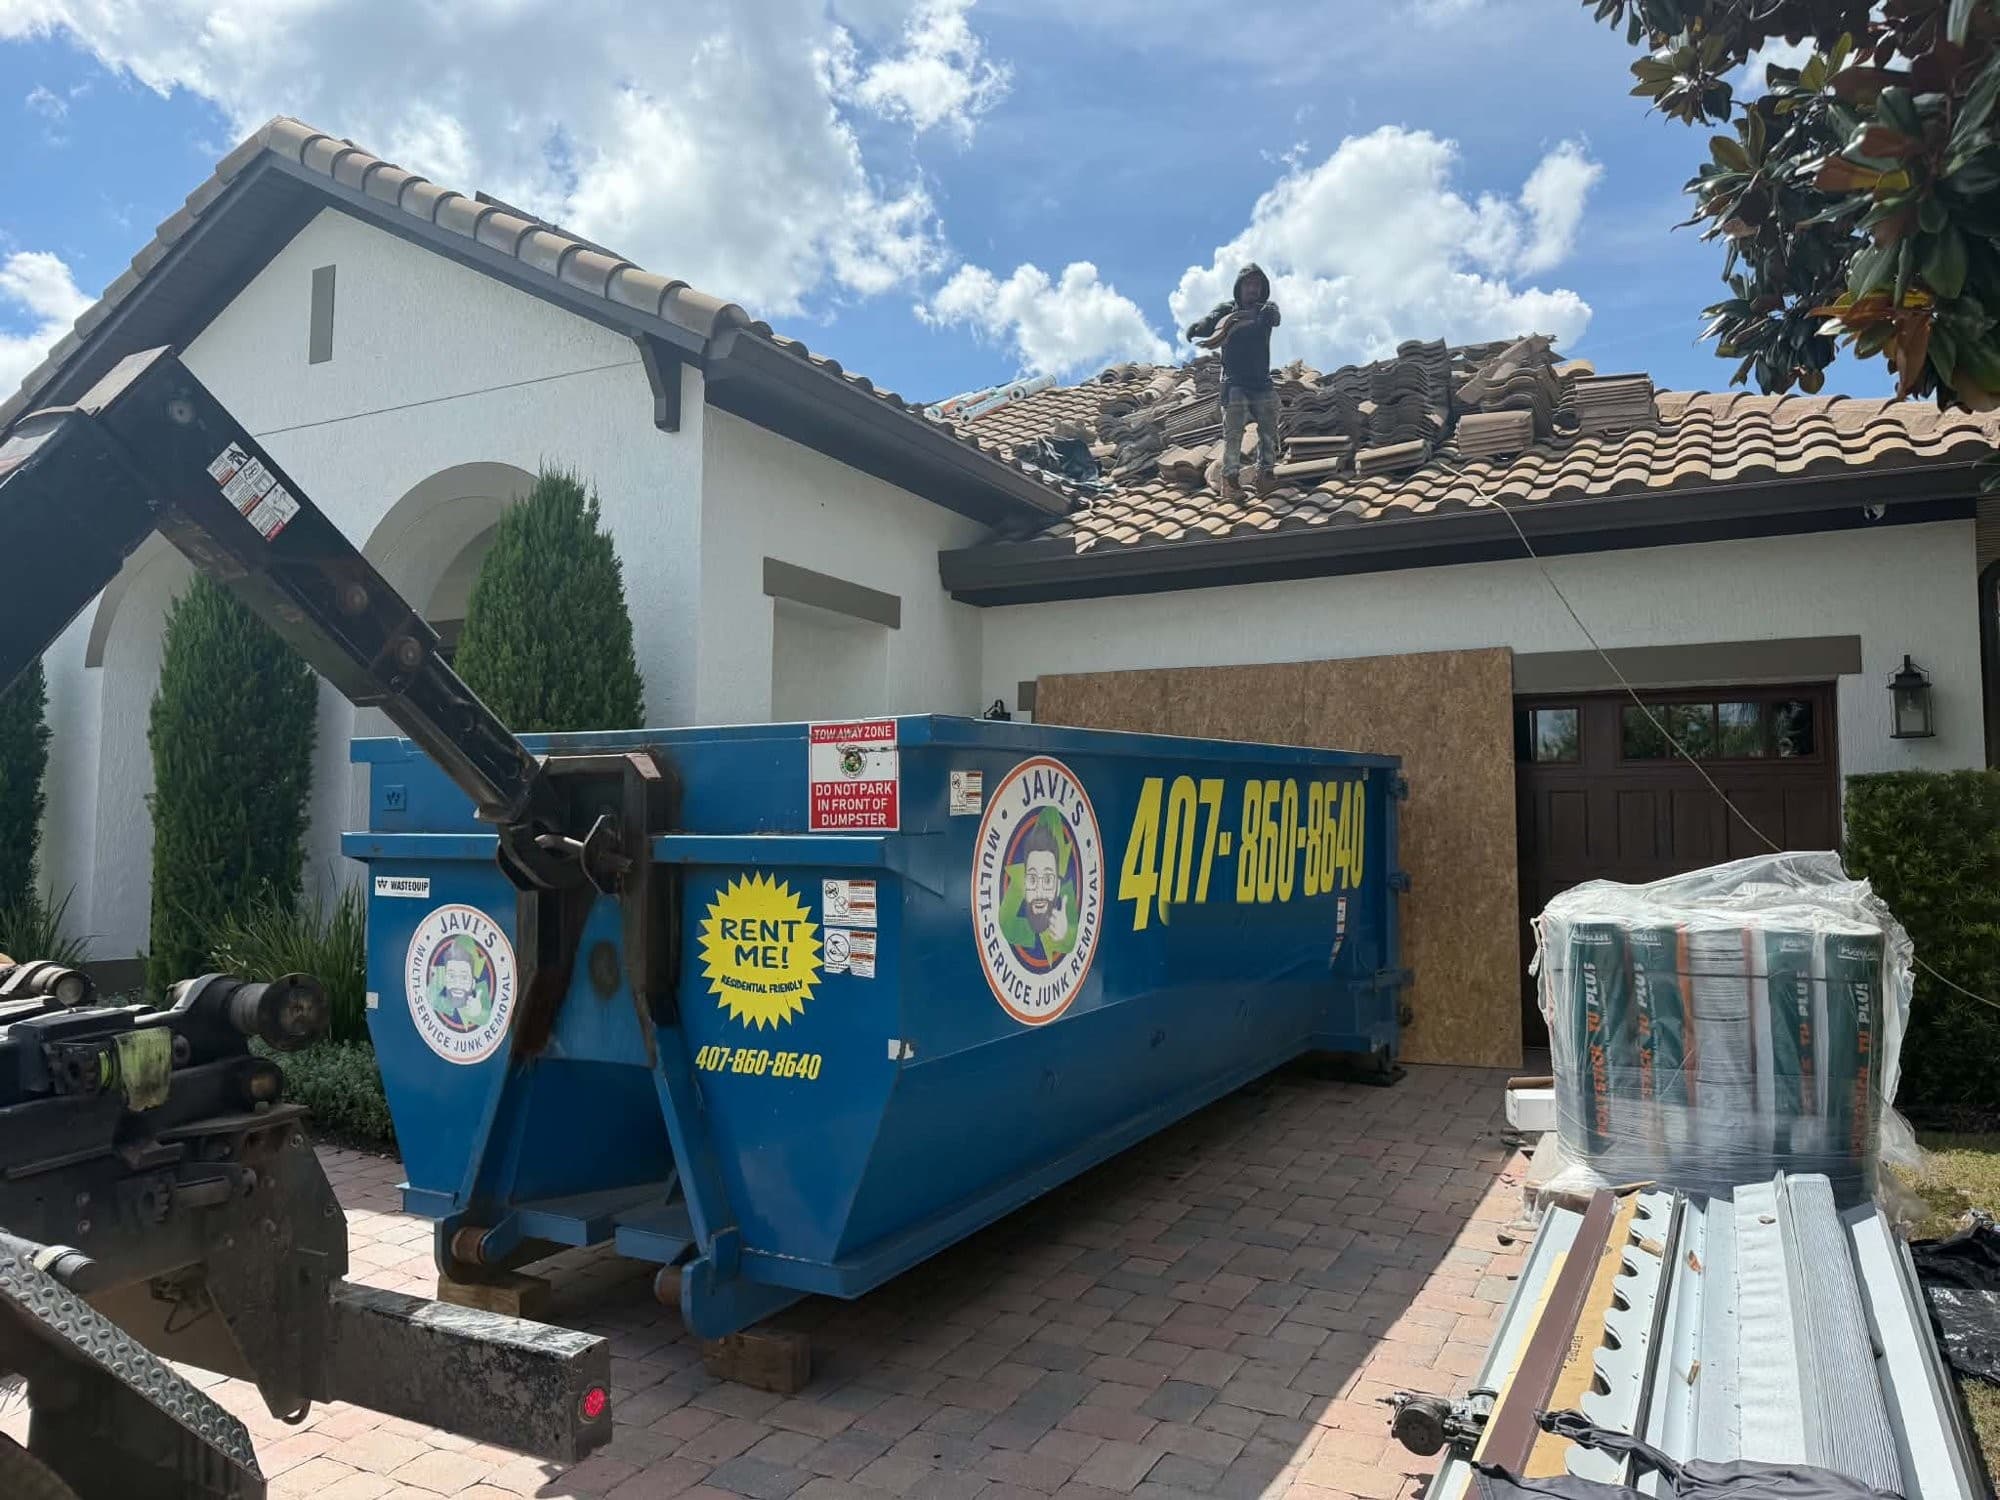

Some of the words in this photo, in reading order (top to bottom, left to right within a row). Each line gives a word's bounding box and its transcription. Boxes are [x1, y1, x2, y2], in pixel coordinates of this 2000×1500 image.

[864, 725, 892, 738] ZONE
[815, 783, 831, 796] DO
[834, 782, 859, 796] NOT
[860, 782, 893, 796] PARK
[1021, 769, 1085, 827] JAVI'S
[817, 799, 829, 811] IN
[831, 798, 871, 811] FRONT
[872, 797, 889, 810] OF
[821, 812, 887, 826] DUMPSTER
[390, 880, 429, 892] WASTEQUIP
[980, 826, 1032, 1005] MULTI-SERVICE
[1035, 972, 1070, 1007] JUNK
[1070, 861, 1098, 976] REMOVAL
[440, 912, 498, 949] JAVI'S
[720, 918, 802, 943] RENT
[734, 944, 789, 970] ME!
[720, 974, 768, 994] RESIDENTIAL
[768, 978, 803, 994] FRIENDLY
[1583, 962, 1599, 1007] PLUS
[1633, 962, 1647, 1009] PLUS
[409, 943, 452, 1049] MULTI-SERVICE
[453, 1036, 483, 1053] JUNK
[485, 970, 512, 1042] REMOVAL
[695, 1045, 823, 1081] 407-860-8640
